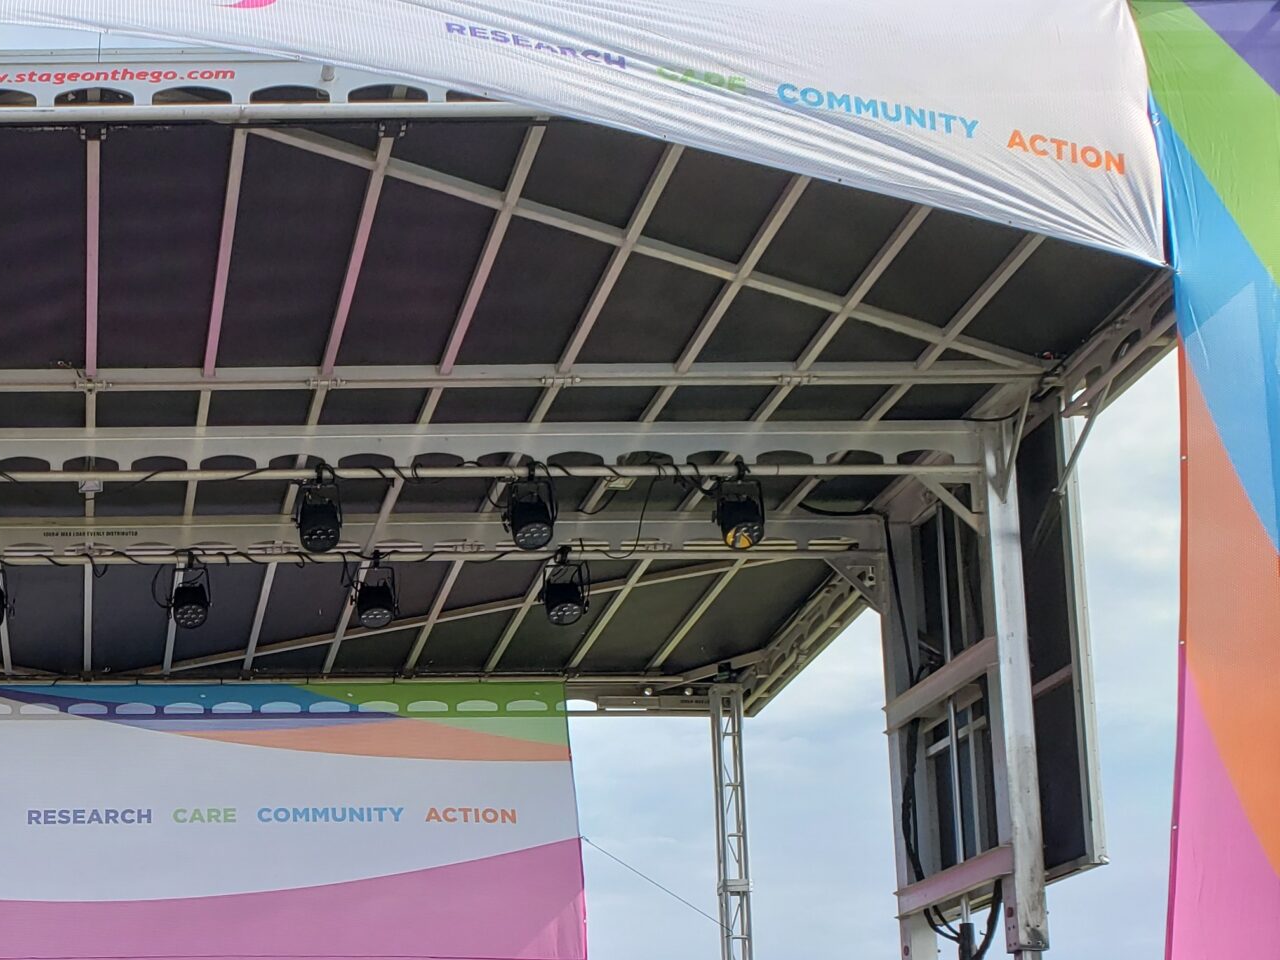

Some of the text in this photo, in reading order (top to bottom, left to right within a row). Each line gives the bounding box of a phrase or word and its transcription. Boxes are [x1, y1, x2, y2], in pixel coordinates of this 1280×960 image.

[777, 83, 979, 138] COMMUNITY
[1007, 129, 1126, 175] ACTION
[27, 807, 518, 825] RESEARCH CARE COMMUNITY ACTION
